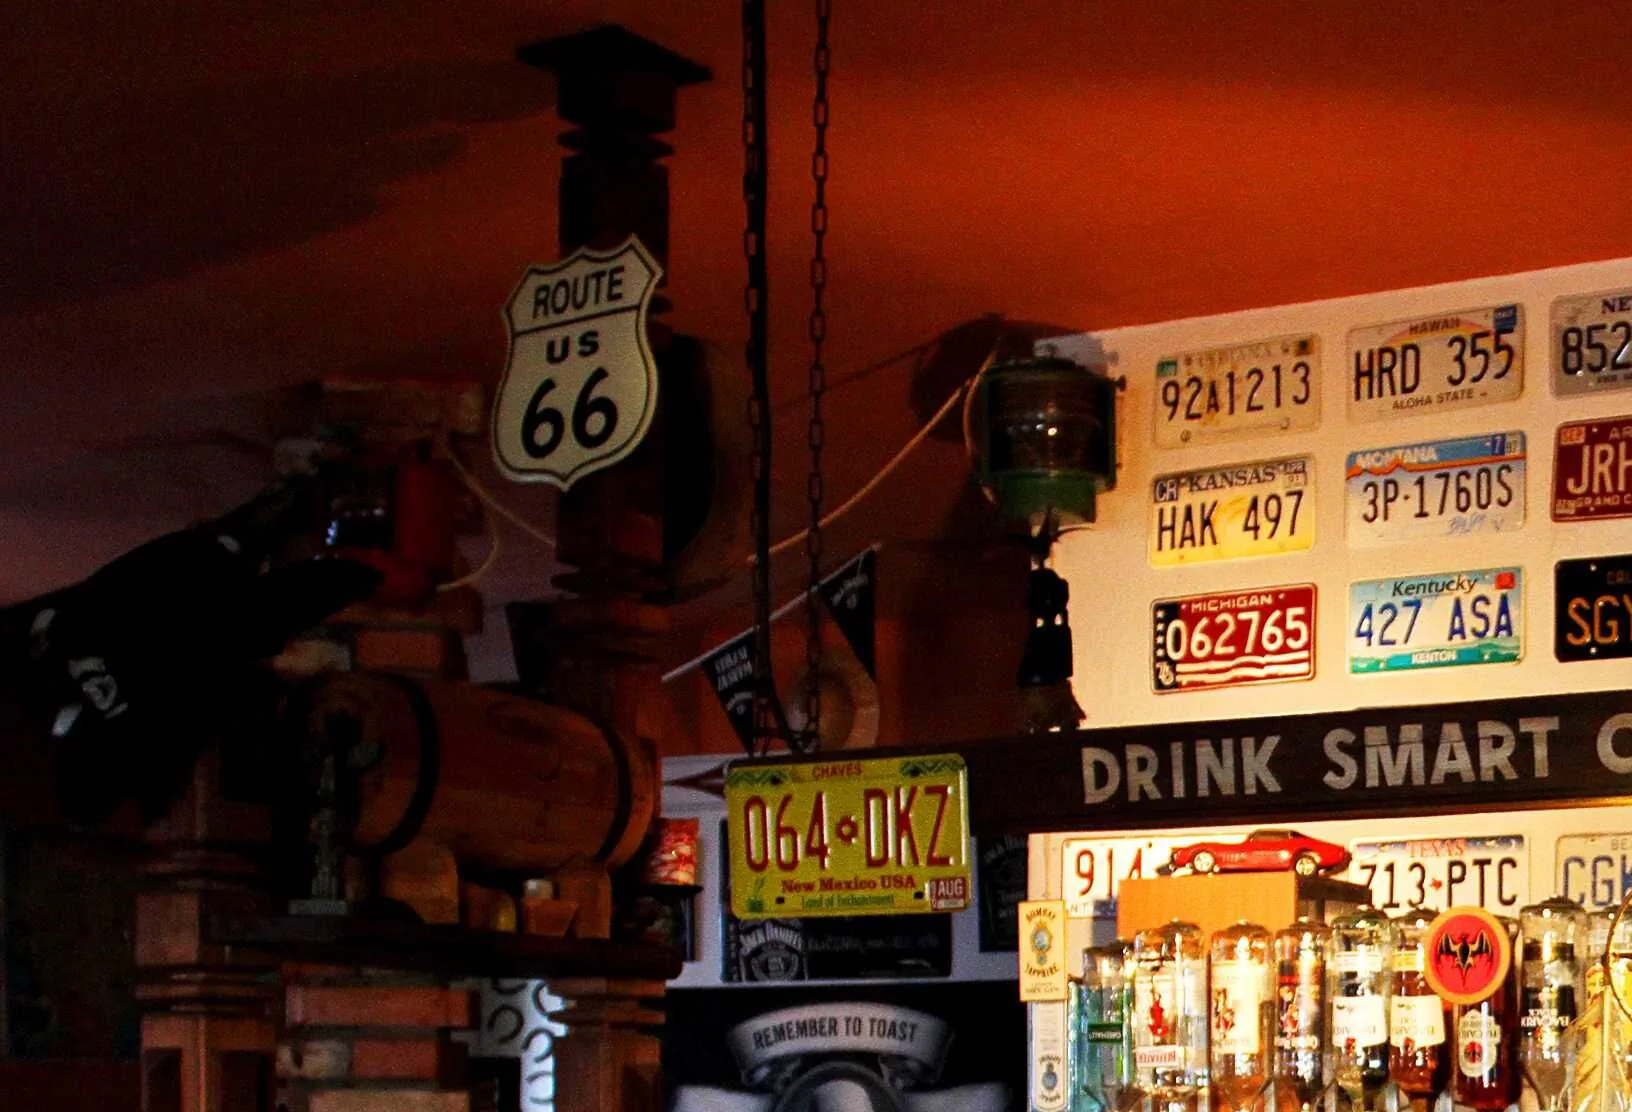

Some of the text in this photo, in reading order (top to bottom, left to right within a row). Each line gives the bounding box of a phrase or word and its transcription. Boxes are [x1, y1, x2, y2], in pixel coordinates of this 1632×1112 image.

[533, 266, 624, 319] ROUTE
[1409, 318, 1461, 335] HAWAII
[546, 330, 599, 363] US
[1354, 343, 1421, 401] HRD
[1447, 327, 1515, 387] 355
[1162, 361, 1310, 422] 92A1213
[1392, 388, 1475, 411] ALOHA STATE
[521, 367, 617, 459] 66
[1187, 465, 1277, 494] KANSAS
[1157, 491, 1305, 553] HAK 497
[1391, 573, 1478, 598] Kentucky
[1191, 594, 1273, 612] MICHIGAN
[1166, 607, 1310, 662] 062765
[1355, 594, 1515, 648] 427 ASA
[811, 762, 863, 778] CHAVES
[1082, 735, 1281, 805] DRINK
[1322, 716, 1560, 790] SMART
[743, 785, 956, 873] 064 DKZ
[1408, 839, 1466, 858] TEXAS
[781, 874, 916, 895] New Mexico USA
[938, 878, 964, 898] AUG
[1447, 856, 1519, 909] PTC
[1025, 906, 1057, 922] BOMBAY
[753, 1015, 919, 1050] REMEMBER TO TOAST
